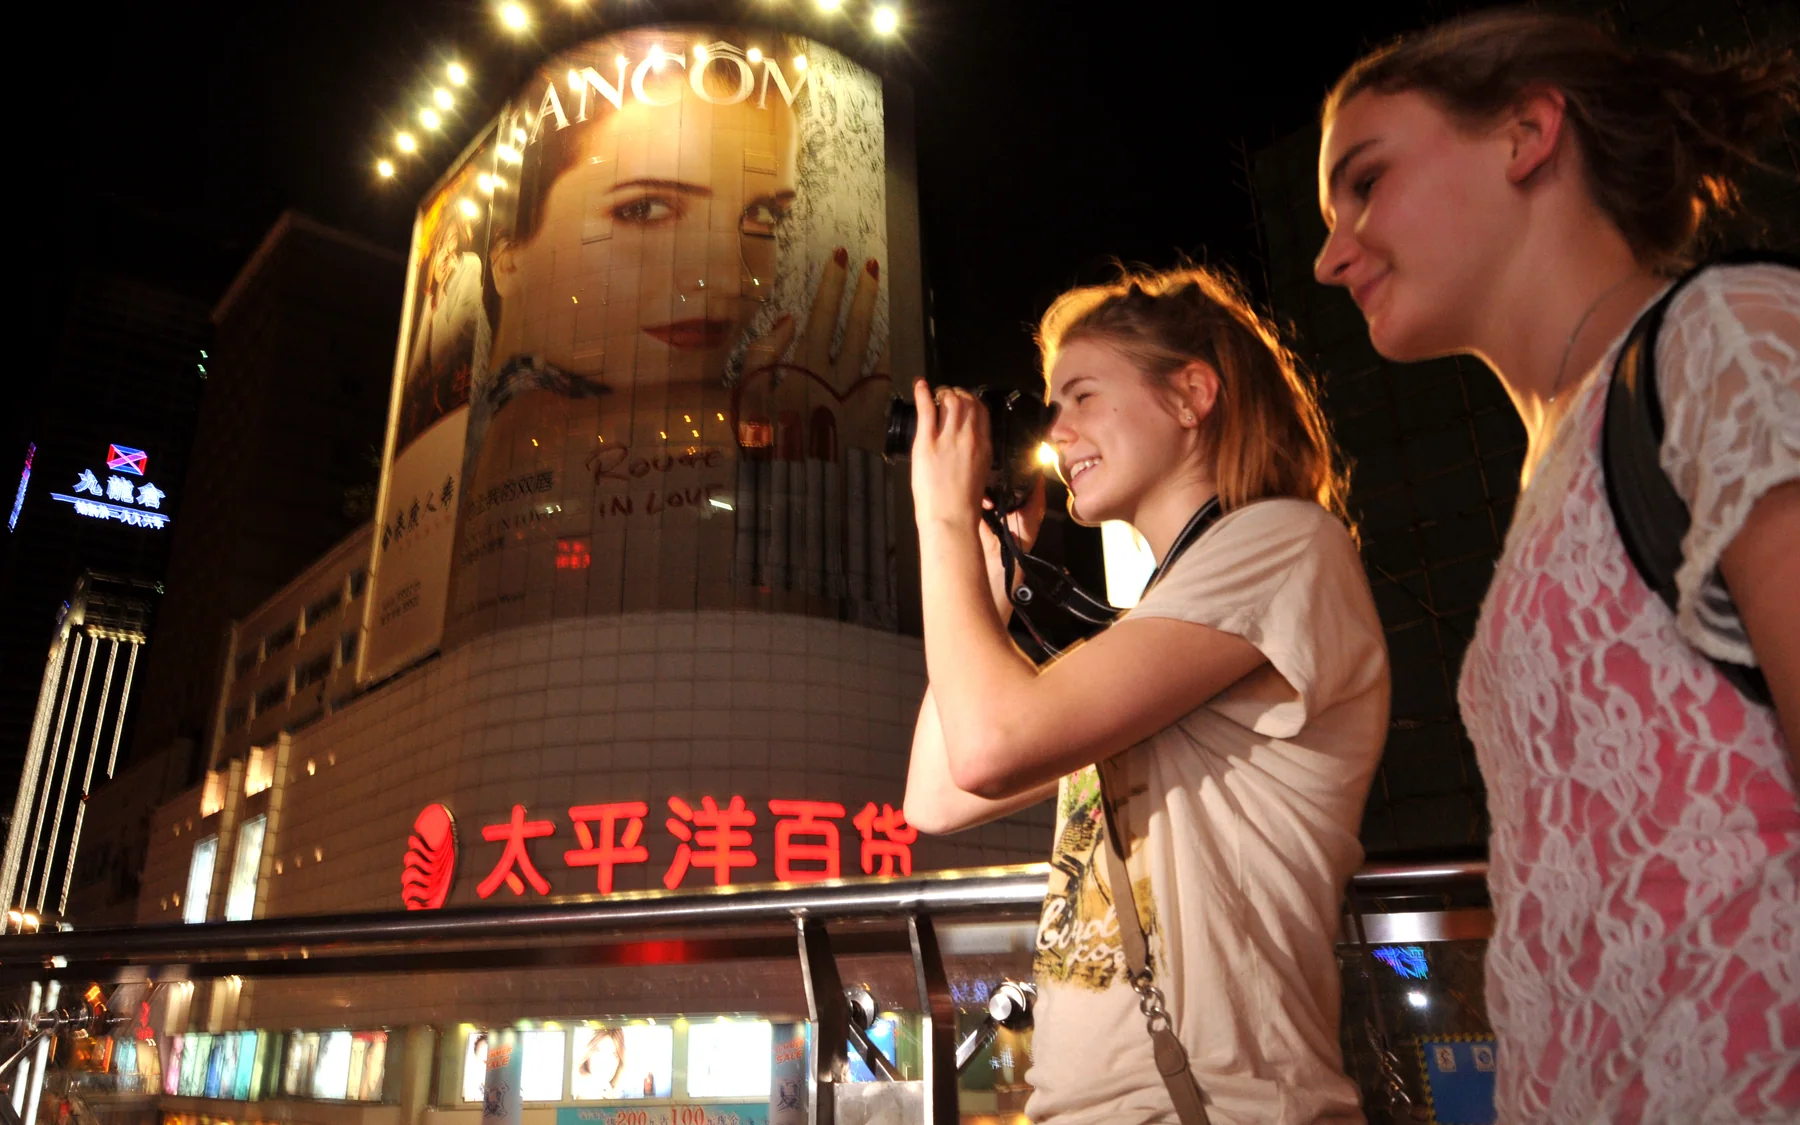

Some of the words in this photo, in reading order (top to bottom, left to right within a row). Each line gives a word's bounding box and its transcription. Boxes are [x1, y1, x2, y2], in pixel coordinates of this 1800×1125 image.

[598, 494, 635, 518] IN
[476, 795, 918, 896] 太平洋百货
[776, 1050, 802, 1064] SALE
